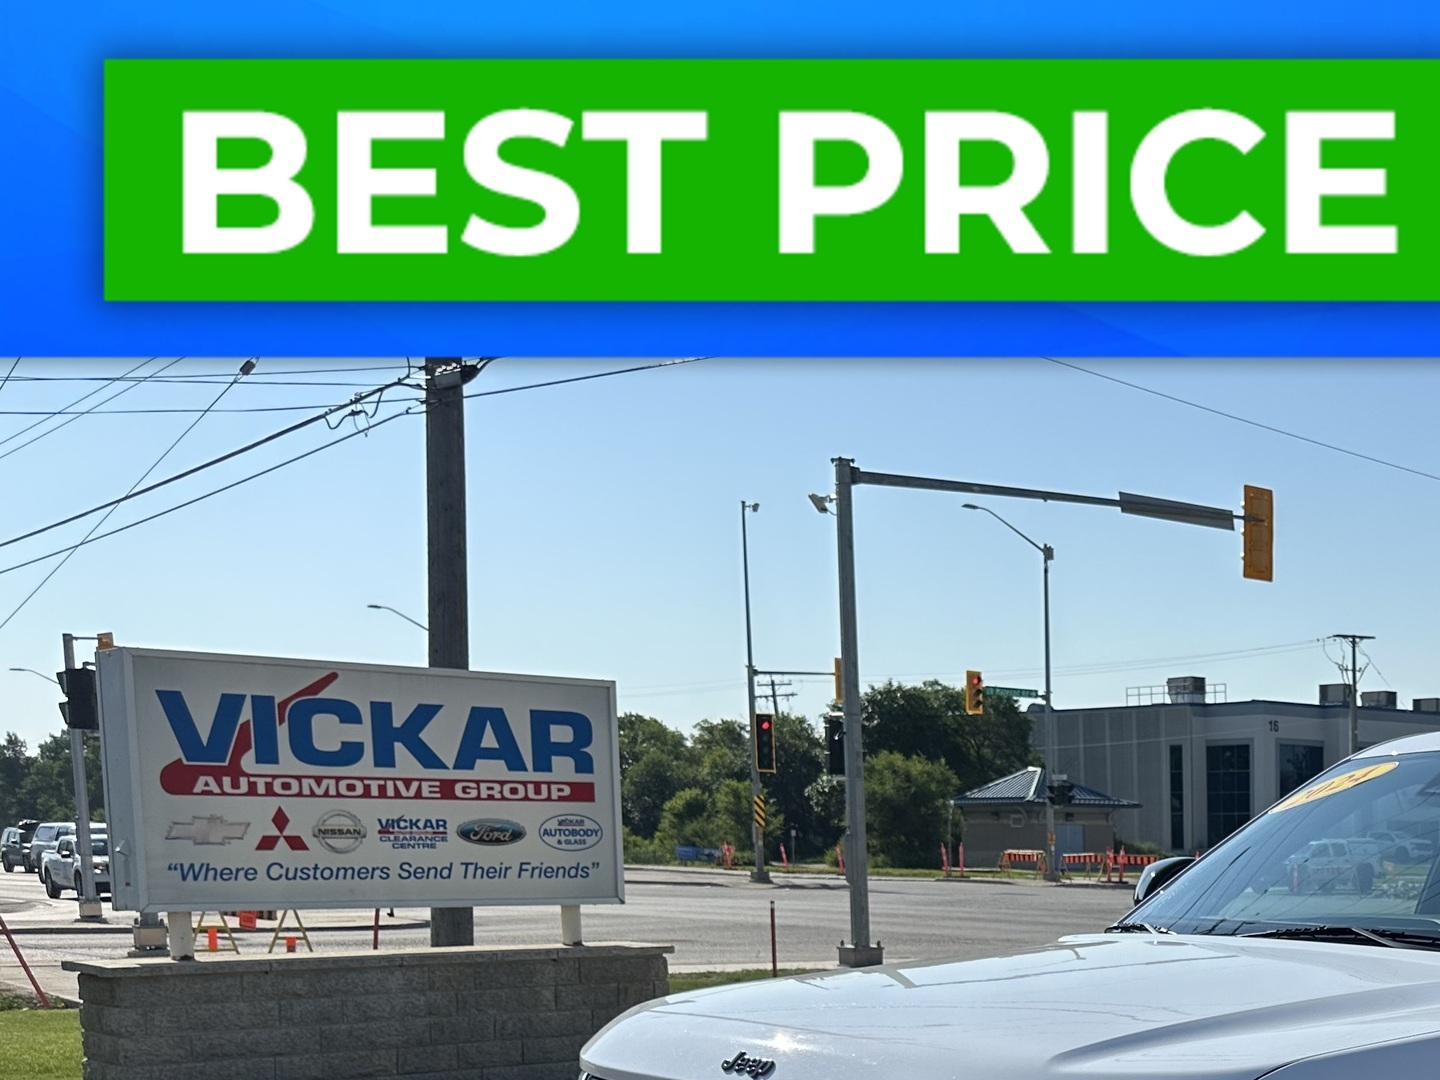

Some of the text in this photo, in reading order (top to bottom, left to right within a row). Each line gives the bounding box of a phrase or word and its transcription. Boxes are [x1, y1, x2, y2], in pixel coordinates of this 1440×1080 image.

[155, 686, 595, 775] VICKAR
[193, 776, 571, 800] AUTOMOTIVE GROUP
[377, 818, 448, 830] VICKAR
[470, 824, 513, 841] Ford
[543, 828, 600, 837] AUTOBODY
[266, 862, 390, 881] Customers
[398, 862, 453, 880] Send
[460, 862, 512, 880] Their
[517, 862, 600, 879] Friends”
[721, 1051, 776, 1080] Jeep
